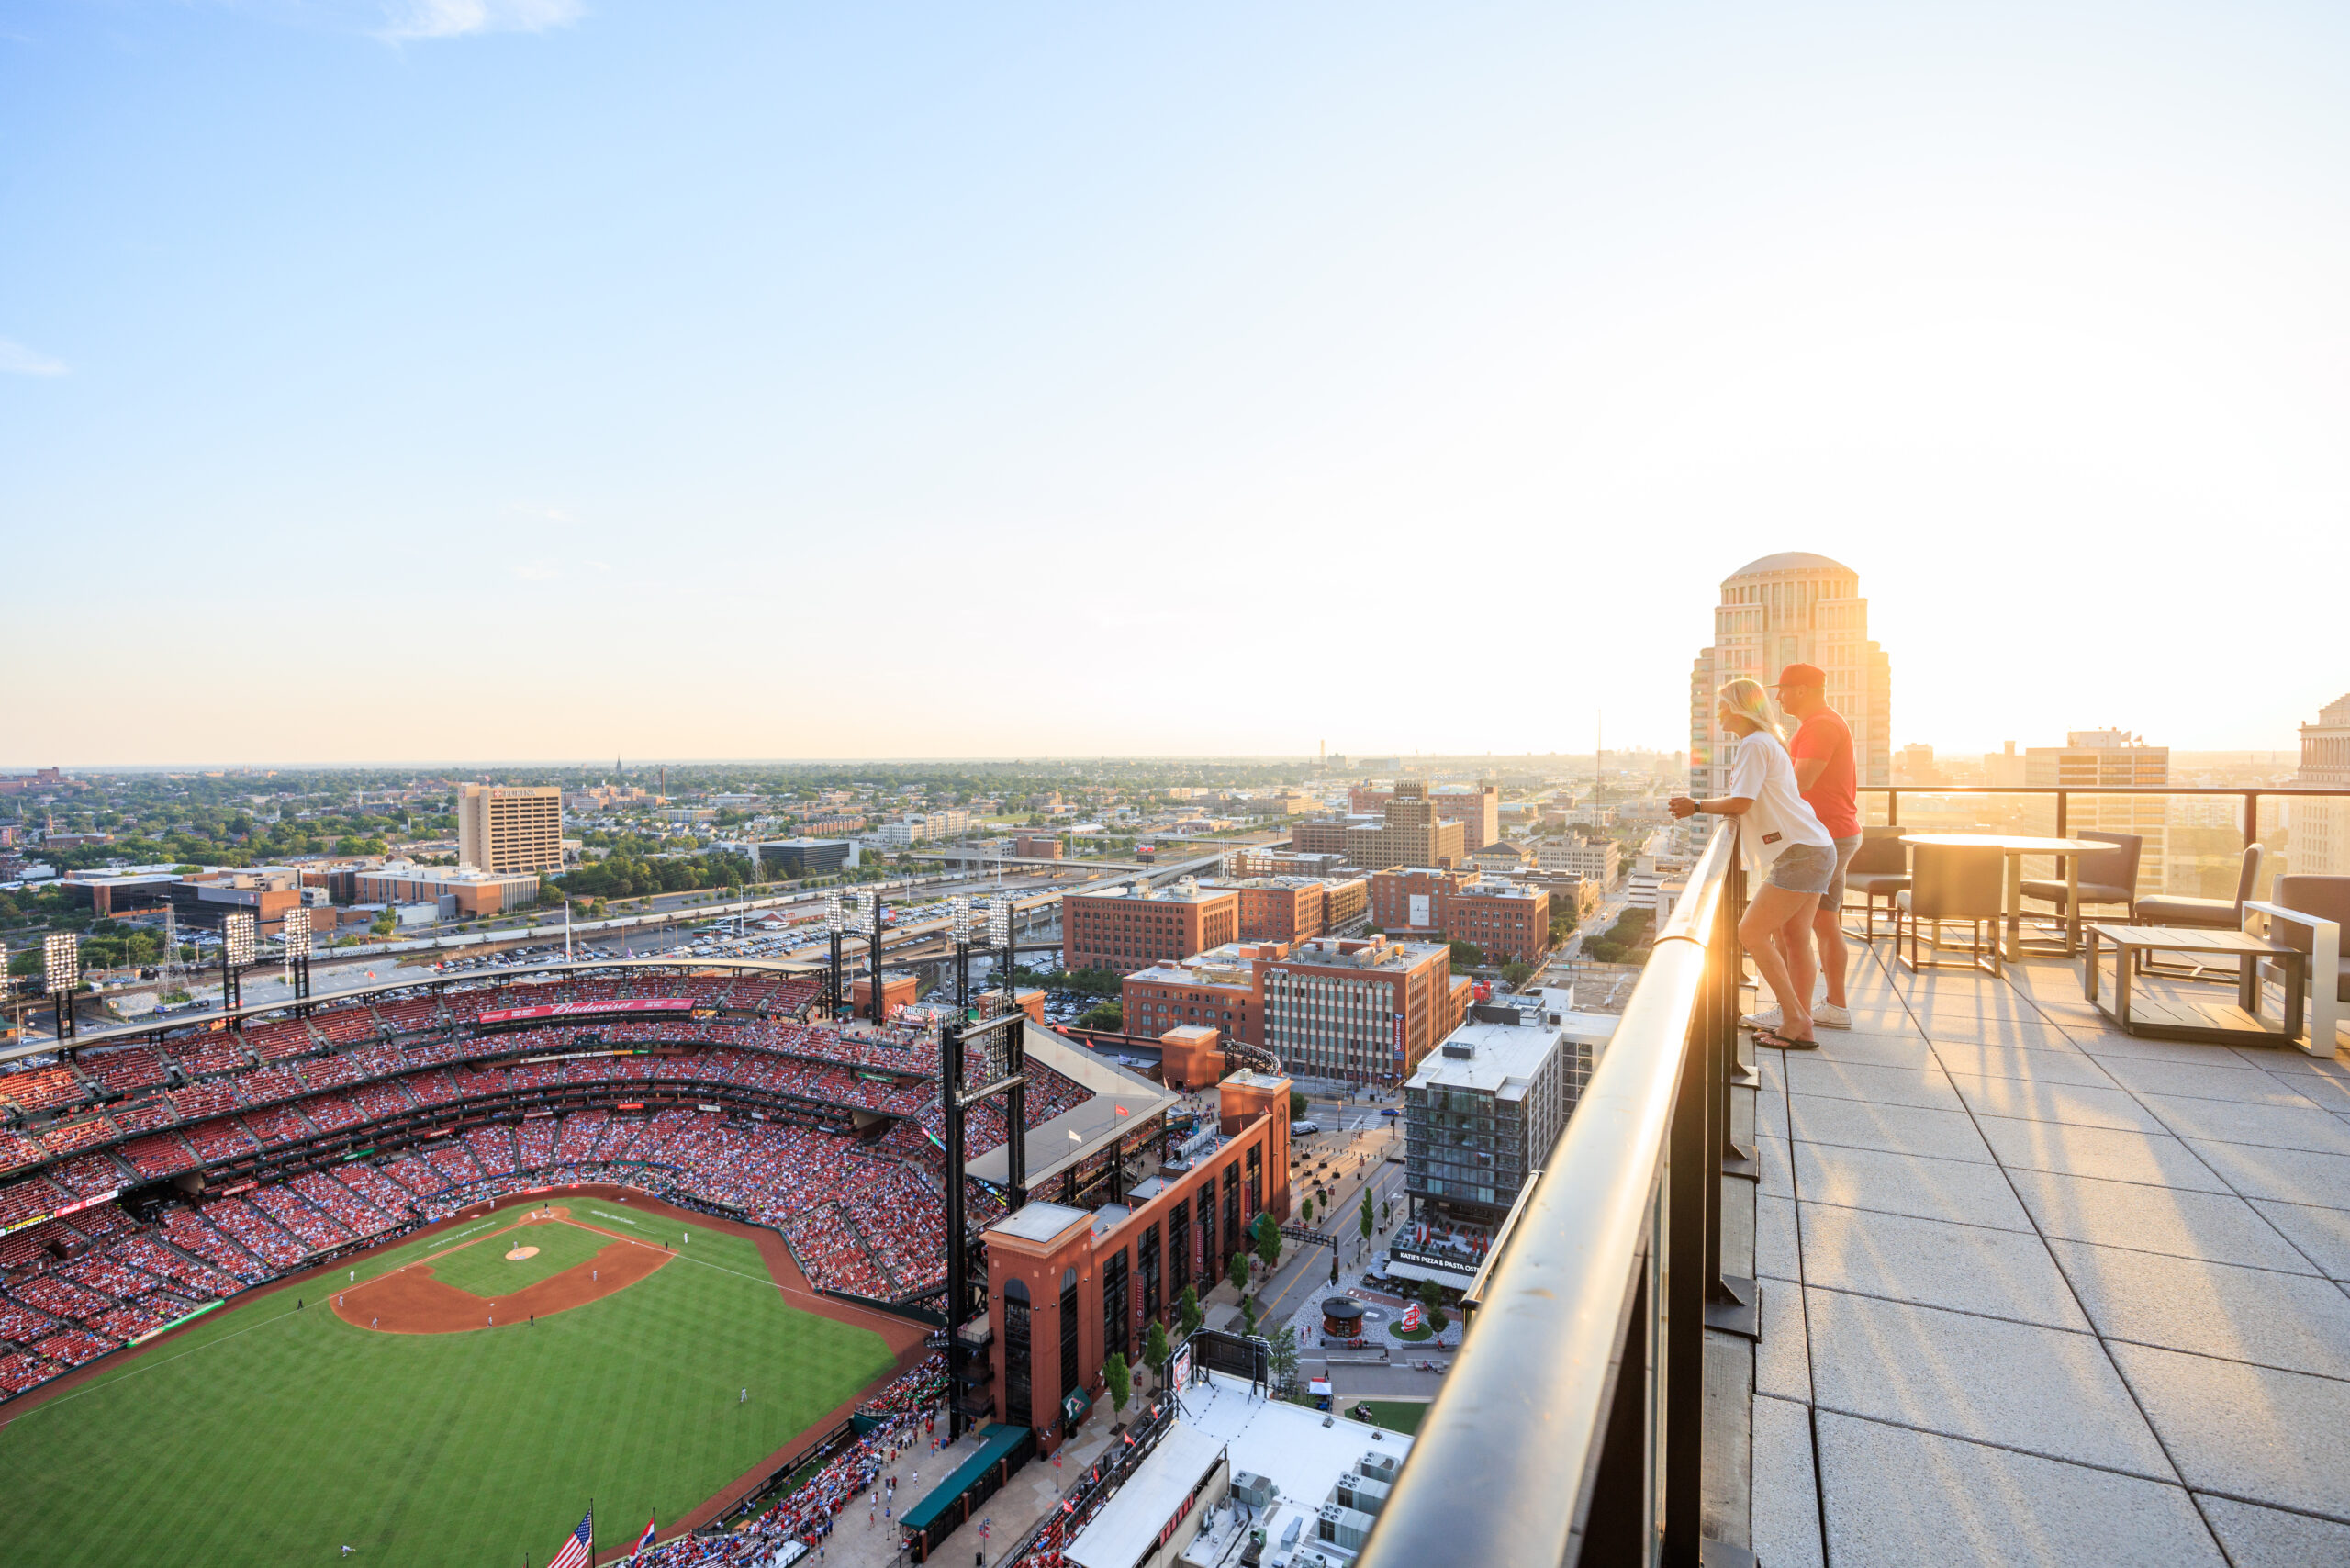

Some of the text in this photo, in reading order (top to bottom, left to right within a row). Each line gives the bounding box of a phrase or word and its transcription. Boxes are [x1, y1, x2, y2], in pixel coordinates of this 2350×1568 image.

[551, 1002, 634, 1014] Budweiser
[1400, 1252, 1420, 1261] KATIE'S
[1421, 1256, 1438, 1265] PIZZA
[1444, 1260, 1464, 1270] PASTA
[1177, 1358, 1188, 1380] 66
